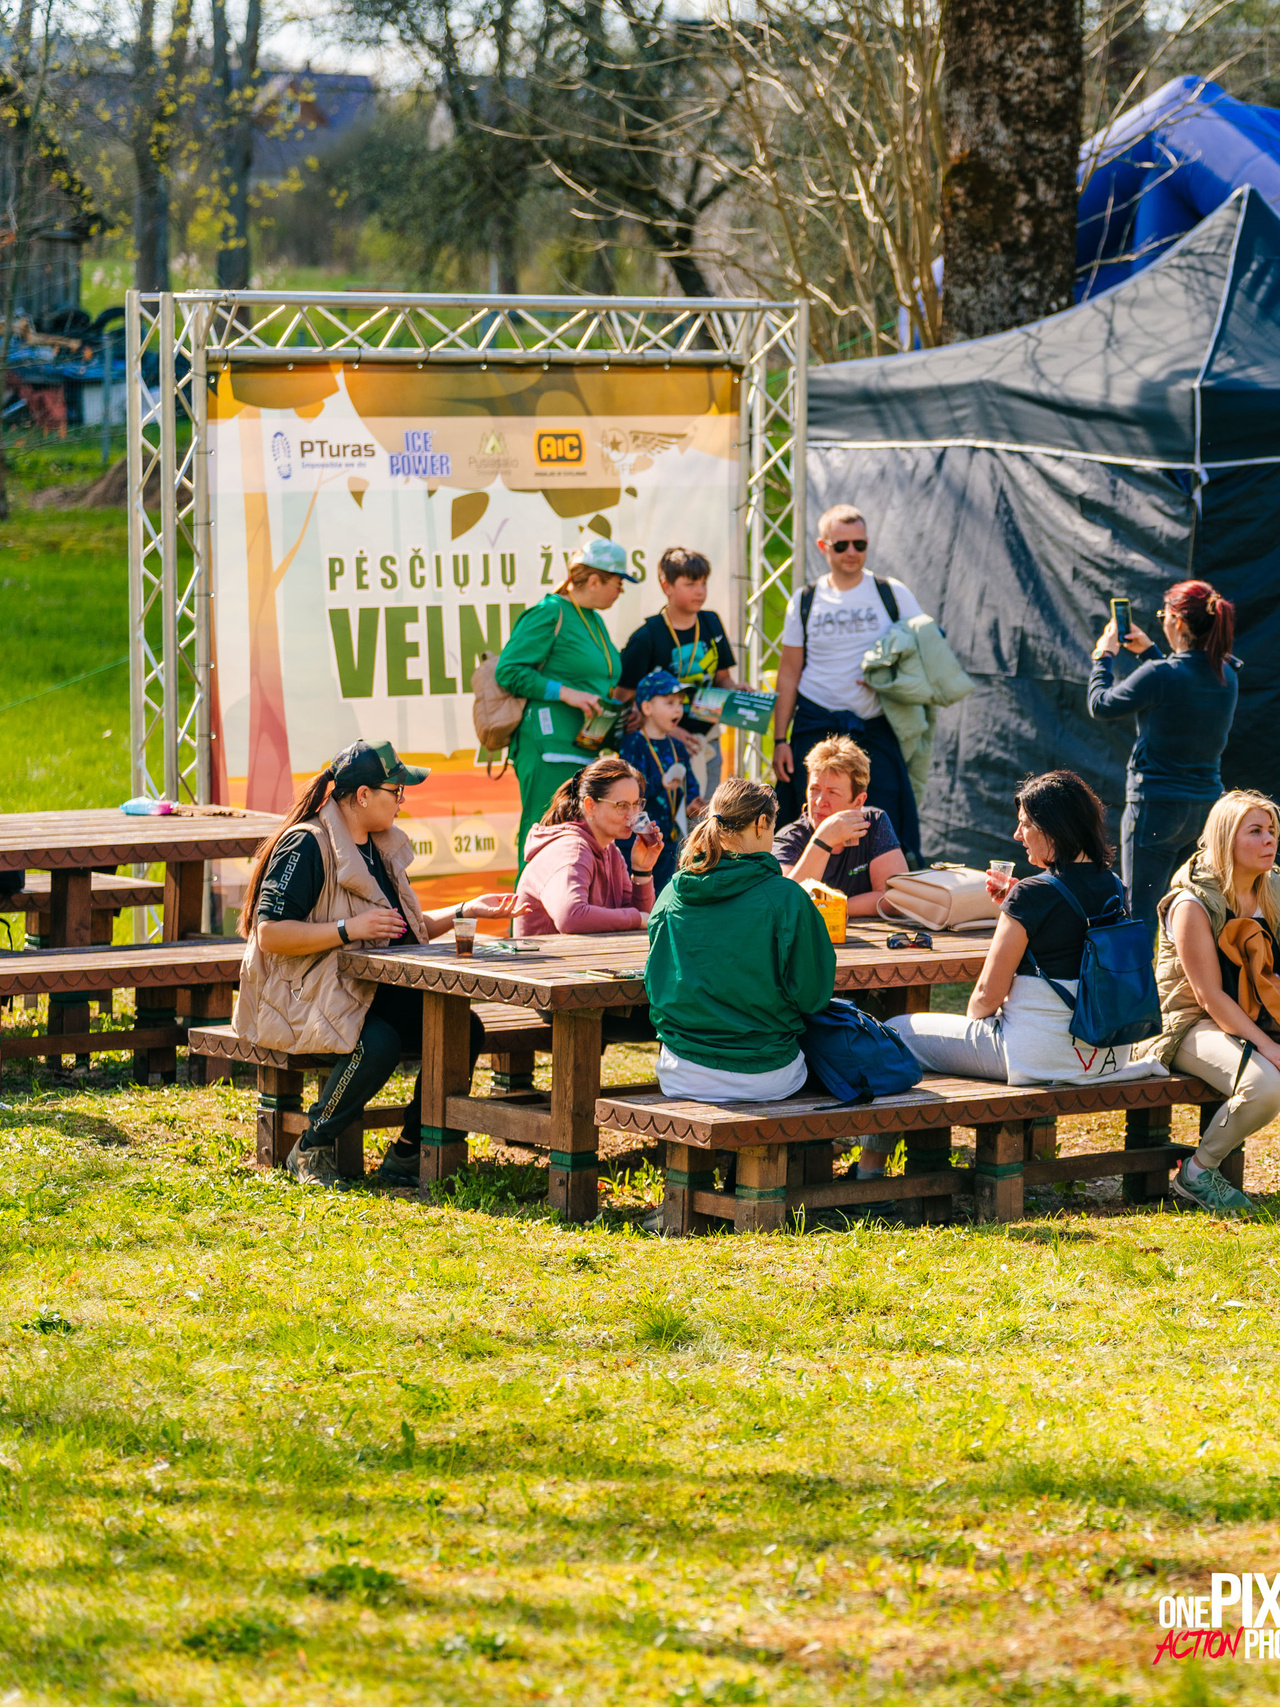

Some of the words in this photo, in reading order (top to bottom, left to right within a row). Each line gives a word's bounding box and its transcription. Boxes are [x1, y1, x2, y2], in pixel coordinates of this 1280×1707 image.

[300, 440, 375, 458] PTuras
[404, 431, 432, 453] ICE
[389, 453, 451, 477] POWER
[328, 547, 515, 593] PĖSČIŲJŲ
[811, 619, 880, 638] JONES
[454, 836, 471, 853] 32
[474, 835, 495, 852] km
